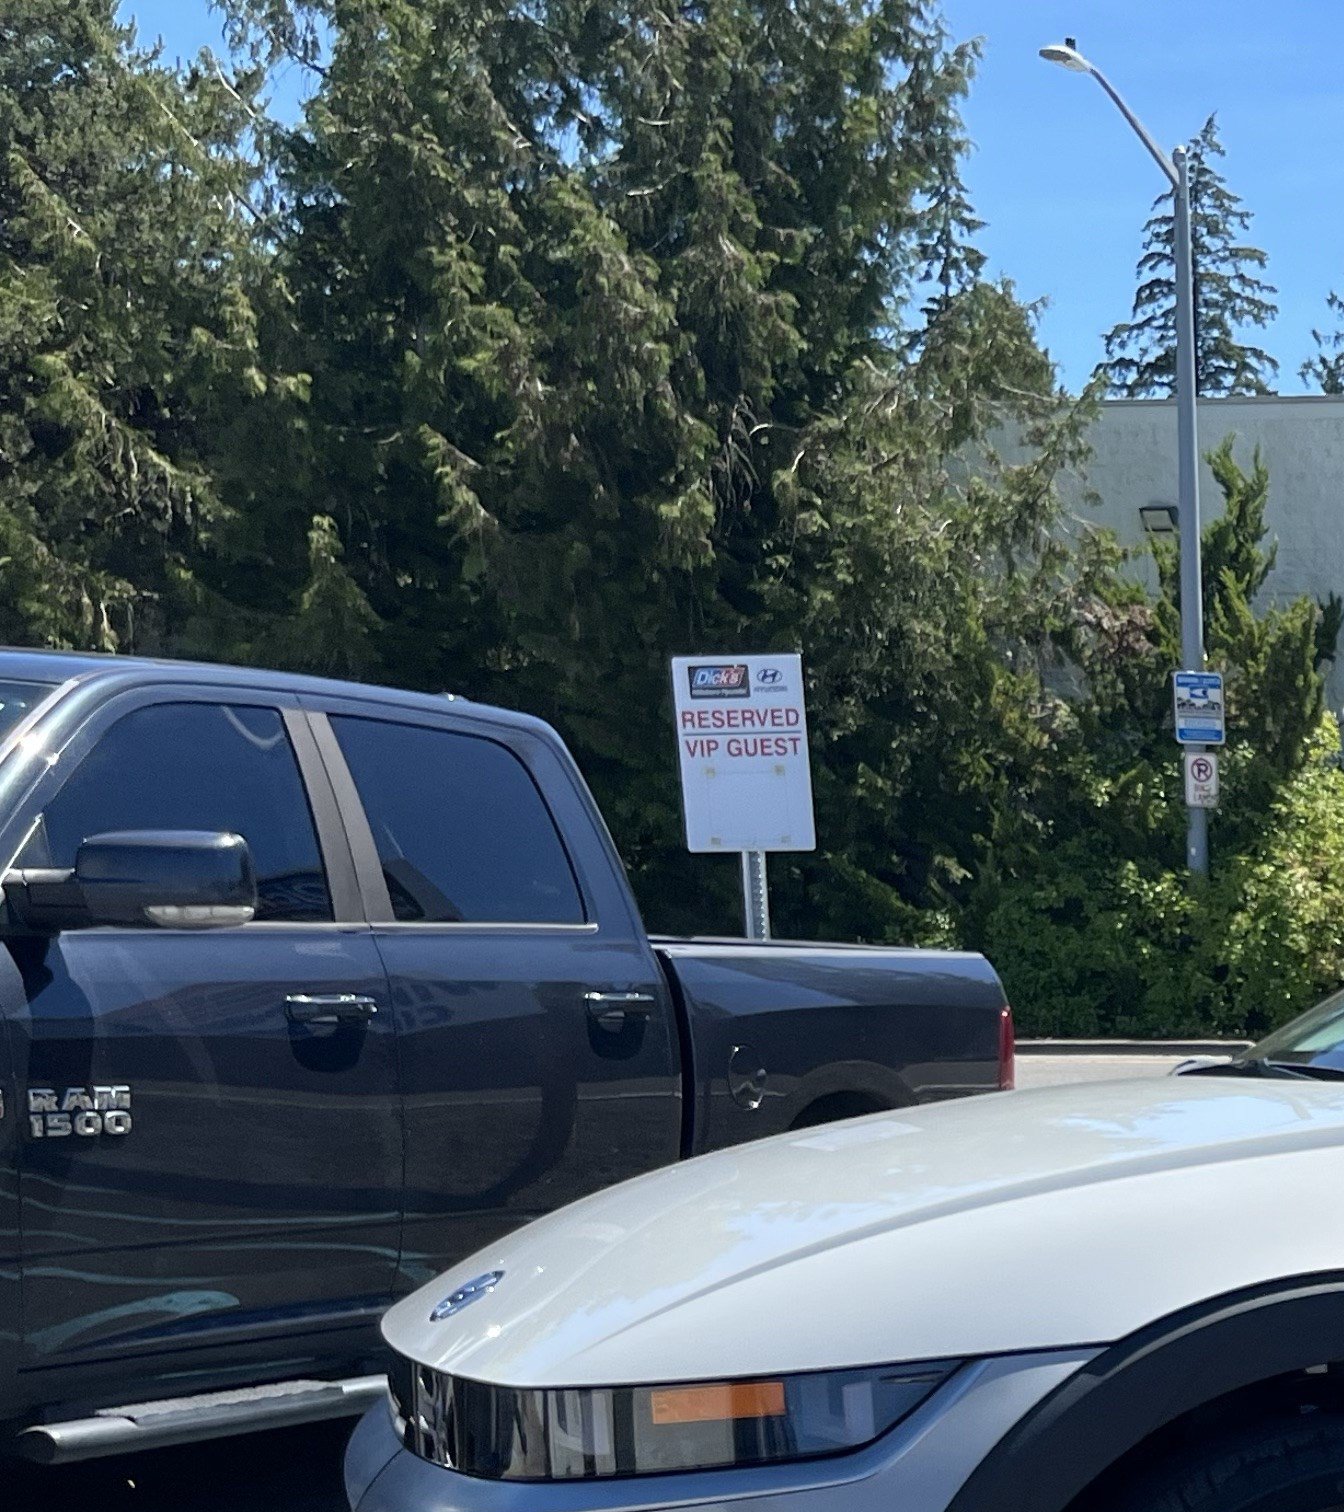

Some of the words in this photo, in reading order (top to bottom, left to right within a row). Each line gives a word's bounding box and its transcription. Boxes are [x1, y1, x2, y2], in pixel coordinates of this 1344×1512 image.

[681, 708, 799, 729] RESERVED
[685, 739, 719, 758] VIP
[727, 738, 801, 757] GUEST
[28, 1085, 132, 1113] RAM
[29, 1110, 133, 1138] 1500
